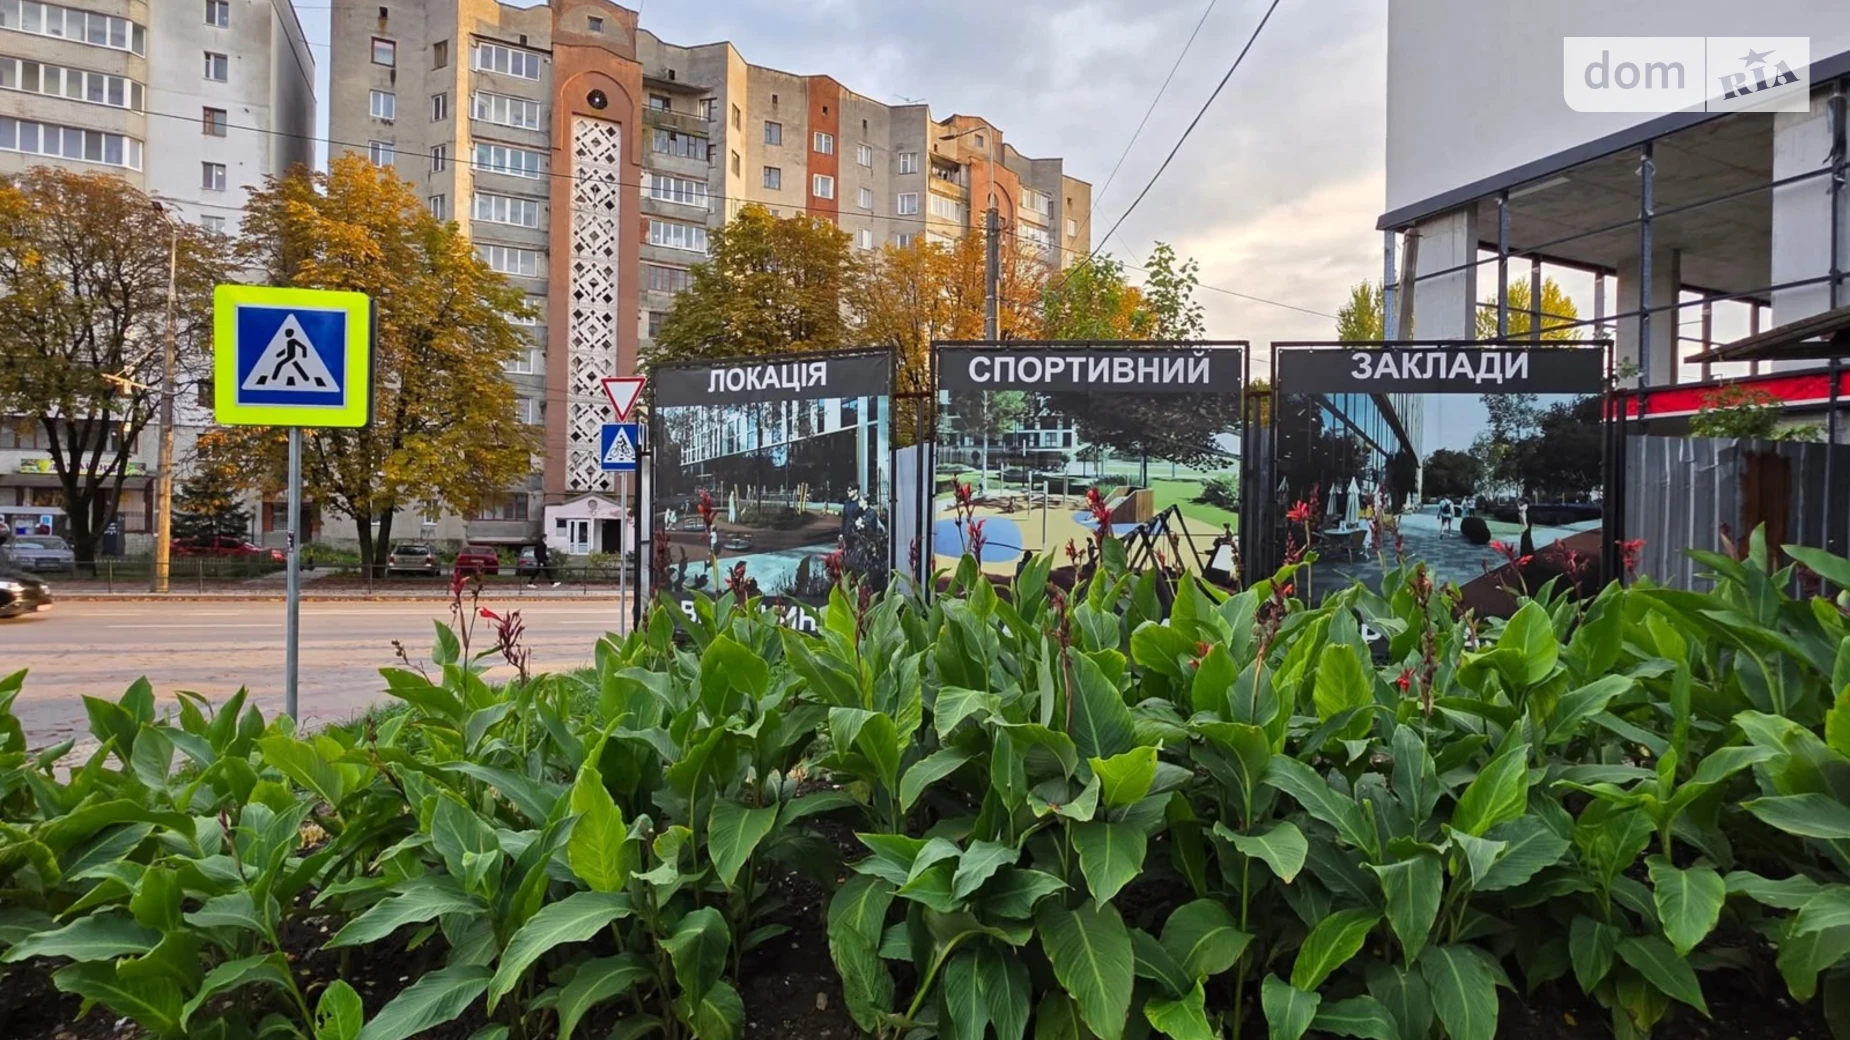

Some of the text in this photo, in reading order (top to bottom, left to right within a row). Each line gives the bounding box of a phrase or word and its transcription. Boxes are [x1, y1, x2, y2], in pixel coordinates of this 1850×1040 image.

[707, 361, 827, 393] ЛОКАЦІЯ
[968, 349, 1210, 384] СПОРТИВНИЙ
[1351, 352, 1528, 384] ЗАКЛАДИ
